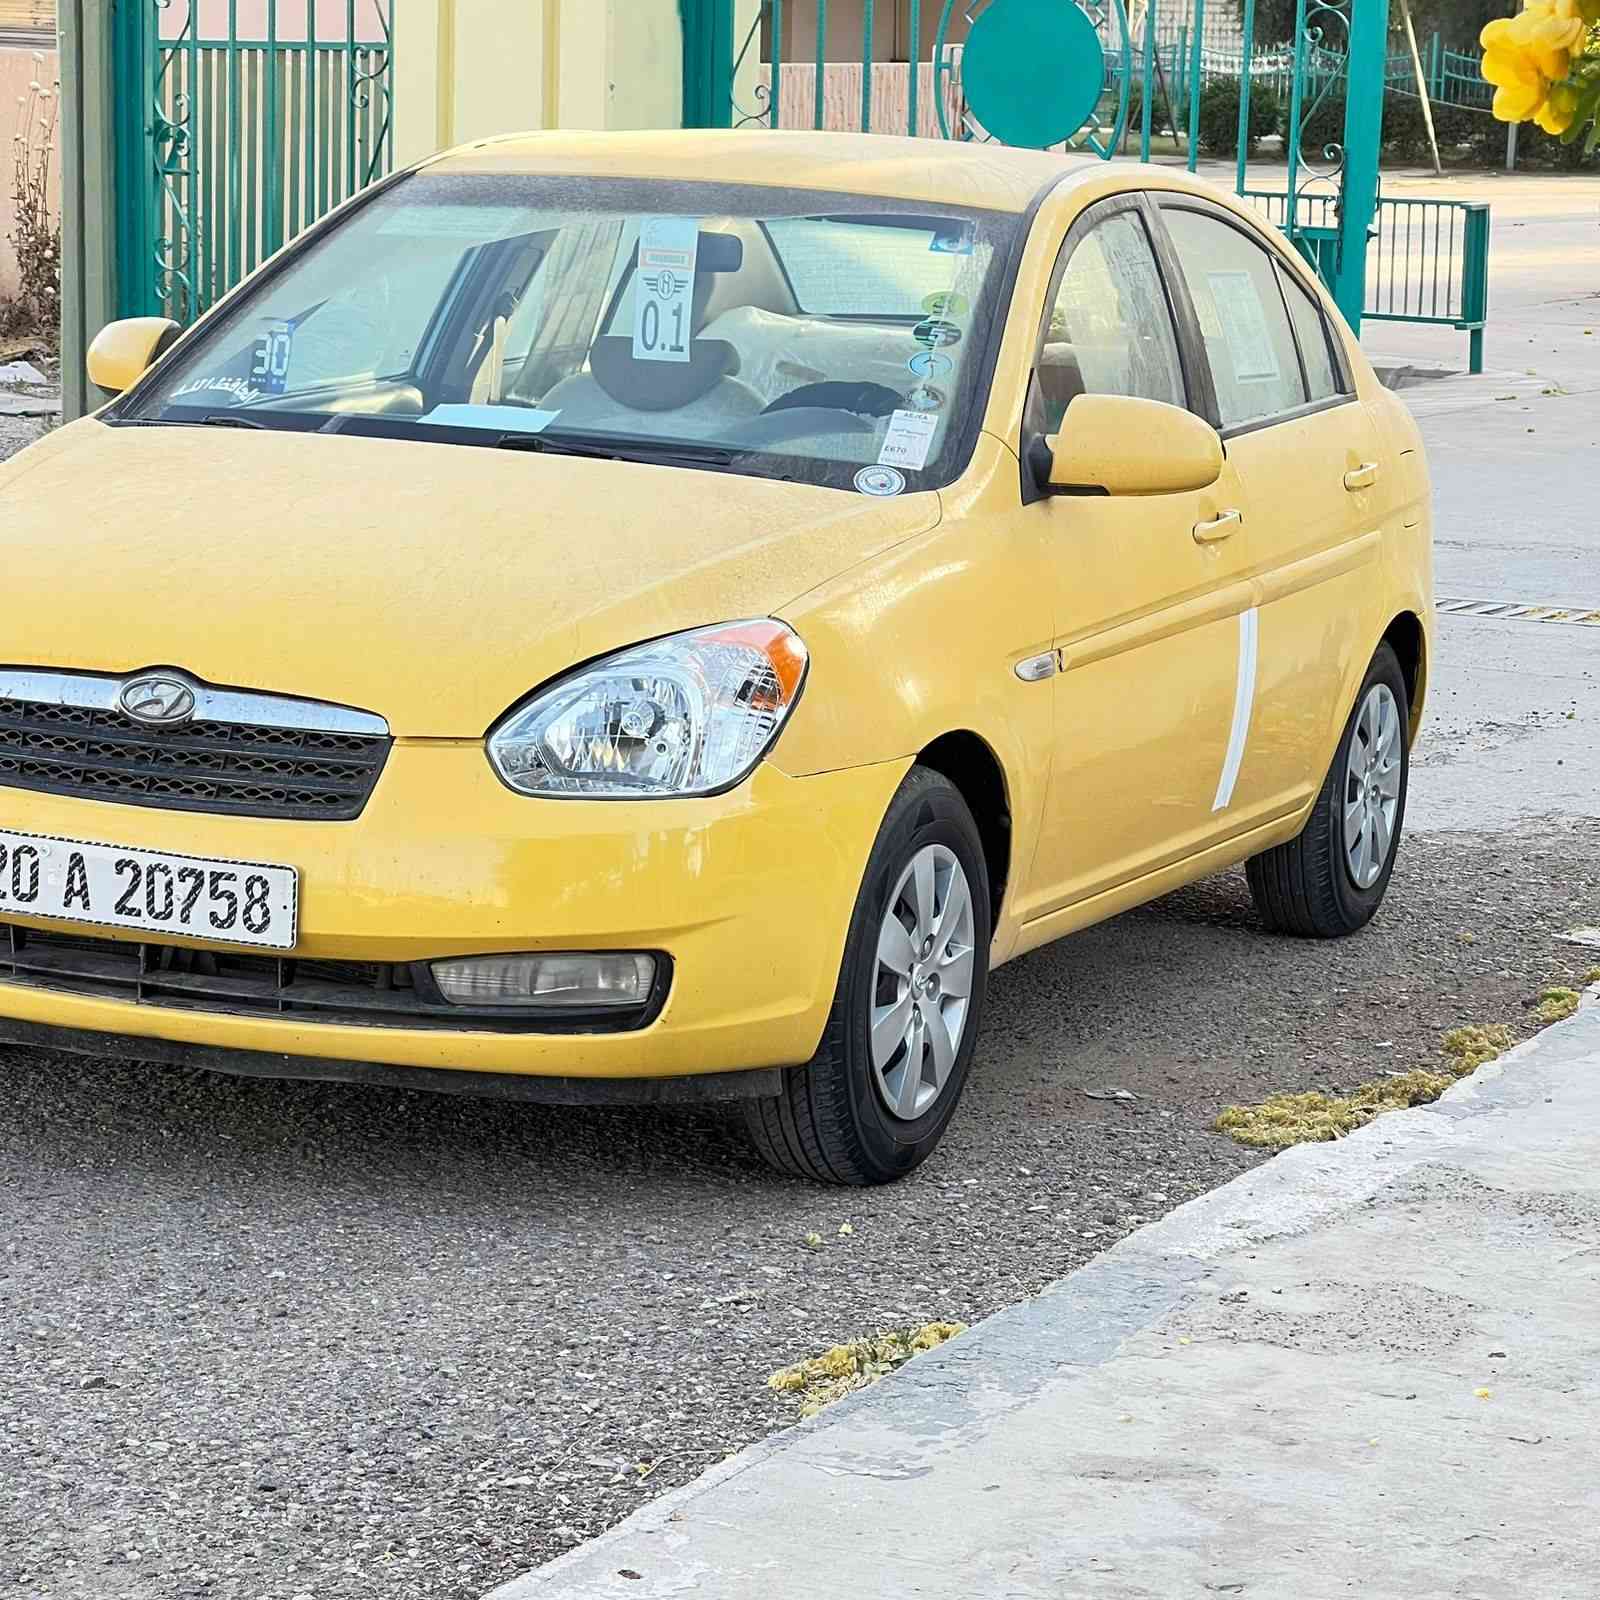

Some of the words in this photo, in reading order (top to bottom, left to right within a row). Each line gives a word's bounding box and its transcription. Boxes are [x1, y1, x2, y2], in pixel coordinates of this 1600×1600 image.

[641, 300, 685, 352] 0.1
[252, 333, 291, 377] 30
[0, 843, 40, 903] 0
[63, 851, 91, 911] A
[114, 857, 272, 935] 20758
